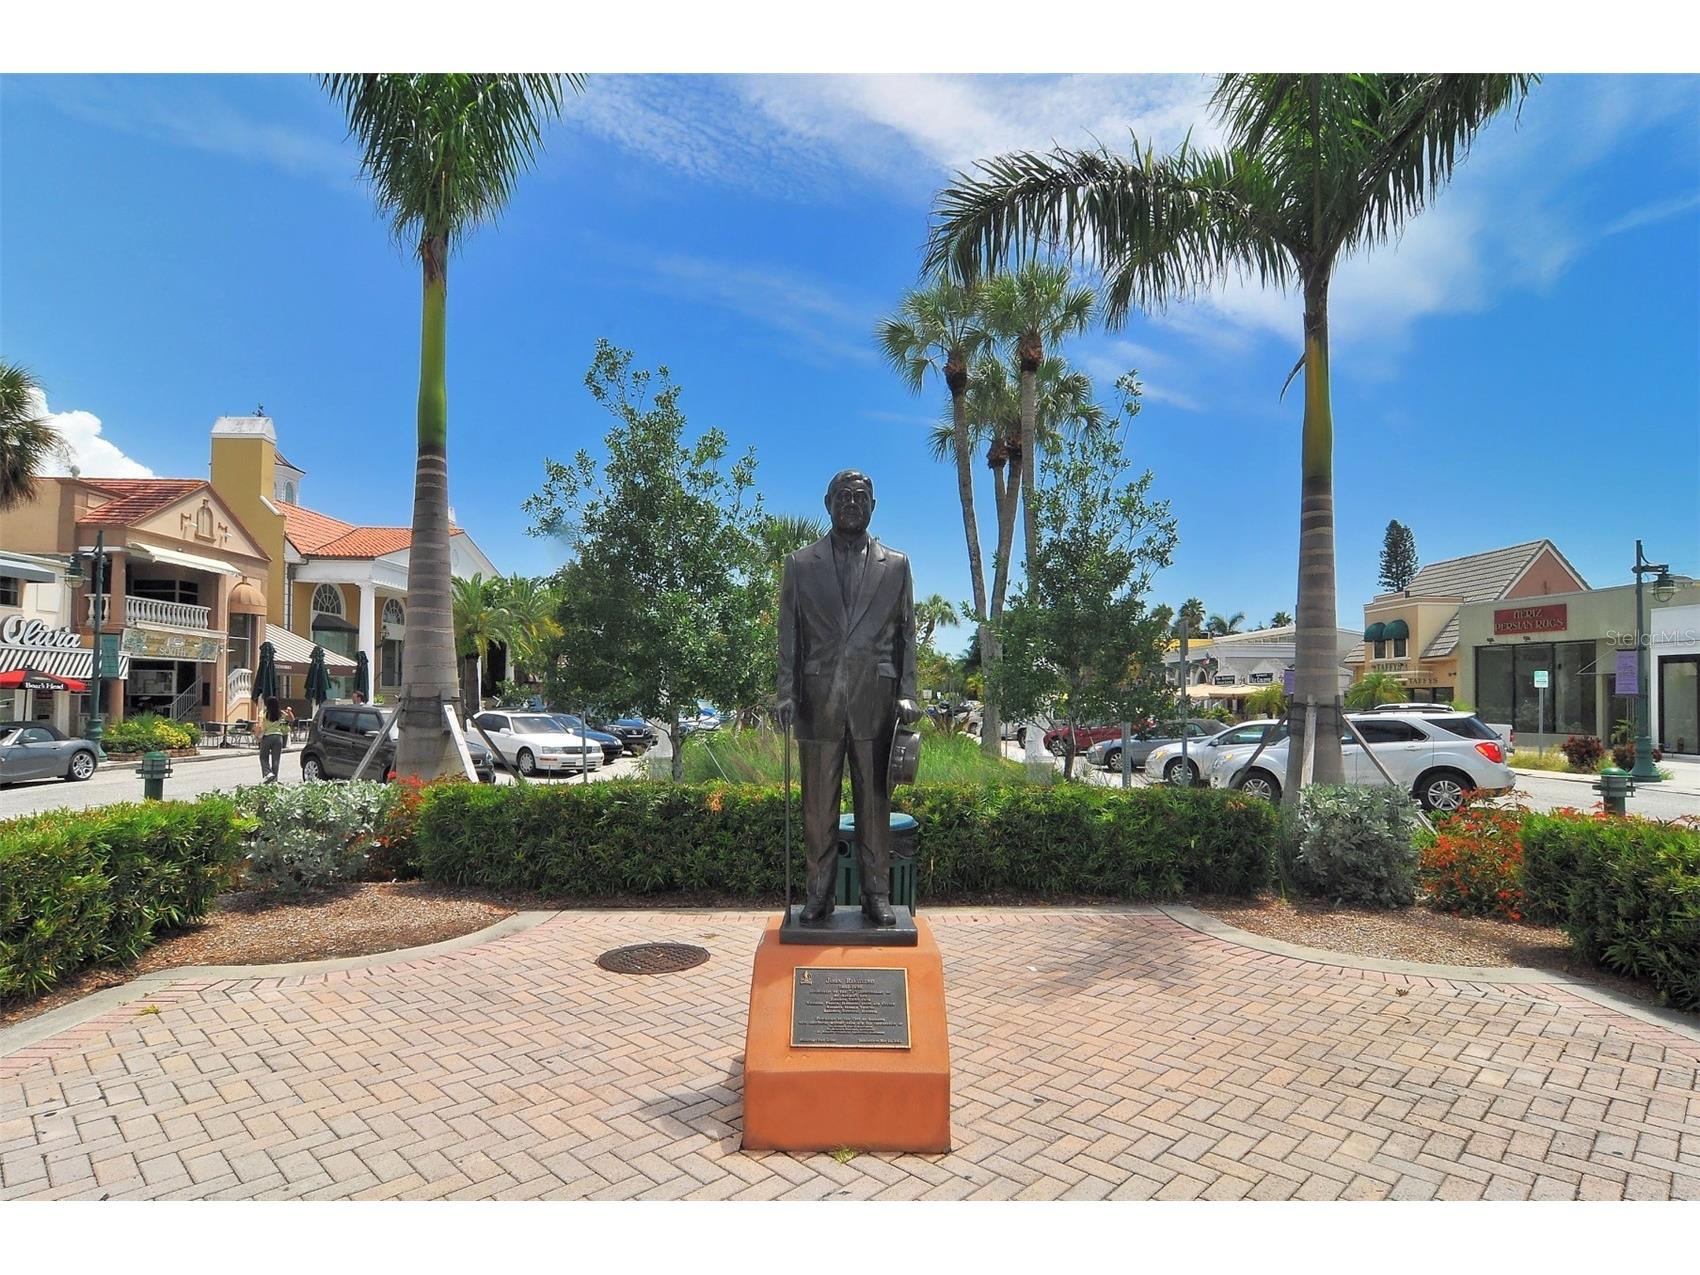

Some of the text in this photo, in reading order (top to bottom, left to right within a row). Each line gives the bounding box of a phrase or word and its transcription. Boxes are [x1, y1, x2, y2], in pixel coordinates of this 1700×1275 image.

[2, 614, 81, 648] Olivia
[1495, 618, 1563, 632] PERSIAN RUGS
[159, 646, 187, 657] SOUTH
